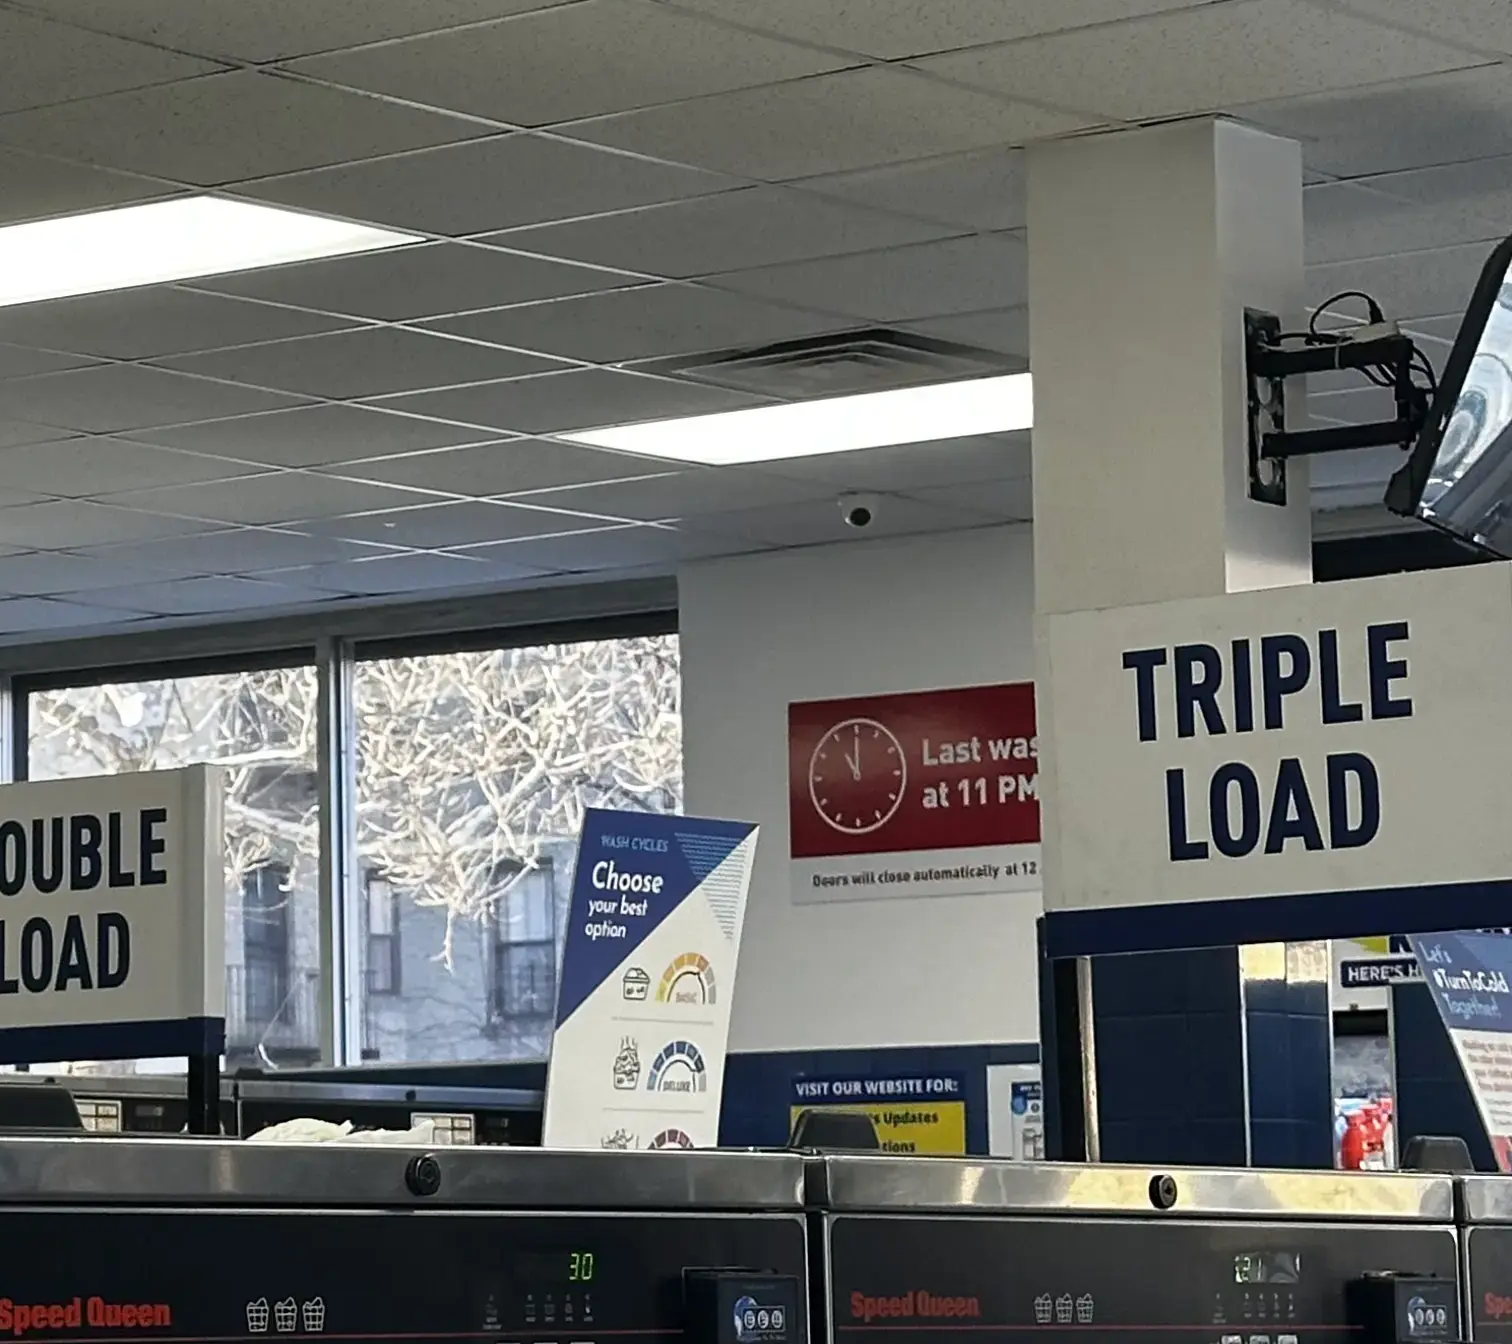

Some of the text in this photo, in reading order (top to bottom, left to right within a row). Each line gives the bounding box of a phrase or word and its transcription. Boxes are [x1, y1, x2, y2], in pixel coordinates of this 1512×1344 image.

[1122, 622, 1413, 742] TRIPLE
[922, 736, 981, 766] Last
[922, 773, 1039, 809] at 11 PM
[1166, 752, 1380, 861] LOAD
[601, 834, 669, 852] WASH CYCLES
[592, 860, 664, 894] Choose
[812, 861, 1037, 888] Doors will close automatically at 12
[588, 894, 648, 917] your best
[584, 919, 627, 941] option
[1418, 941, 1452, 964] Let's
[1348, 966, 1404, 982] HERE'S
[795, 1078, 959, 1097] VISIT OUR WEBSITE FOR:
[883, 1111, 939, 1128] Updates
[569, 1253, 593, 1280] 30
[87, 1296, 171, 1327] Queen
[850, 1290, 980, 1323] Speed Queen
